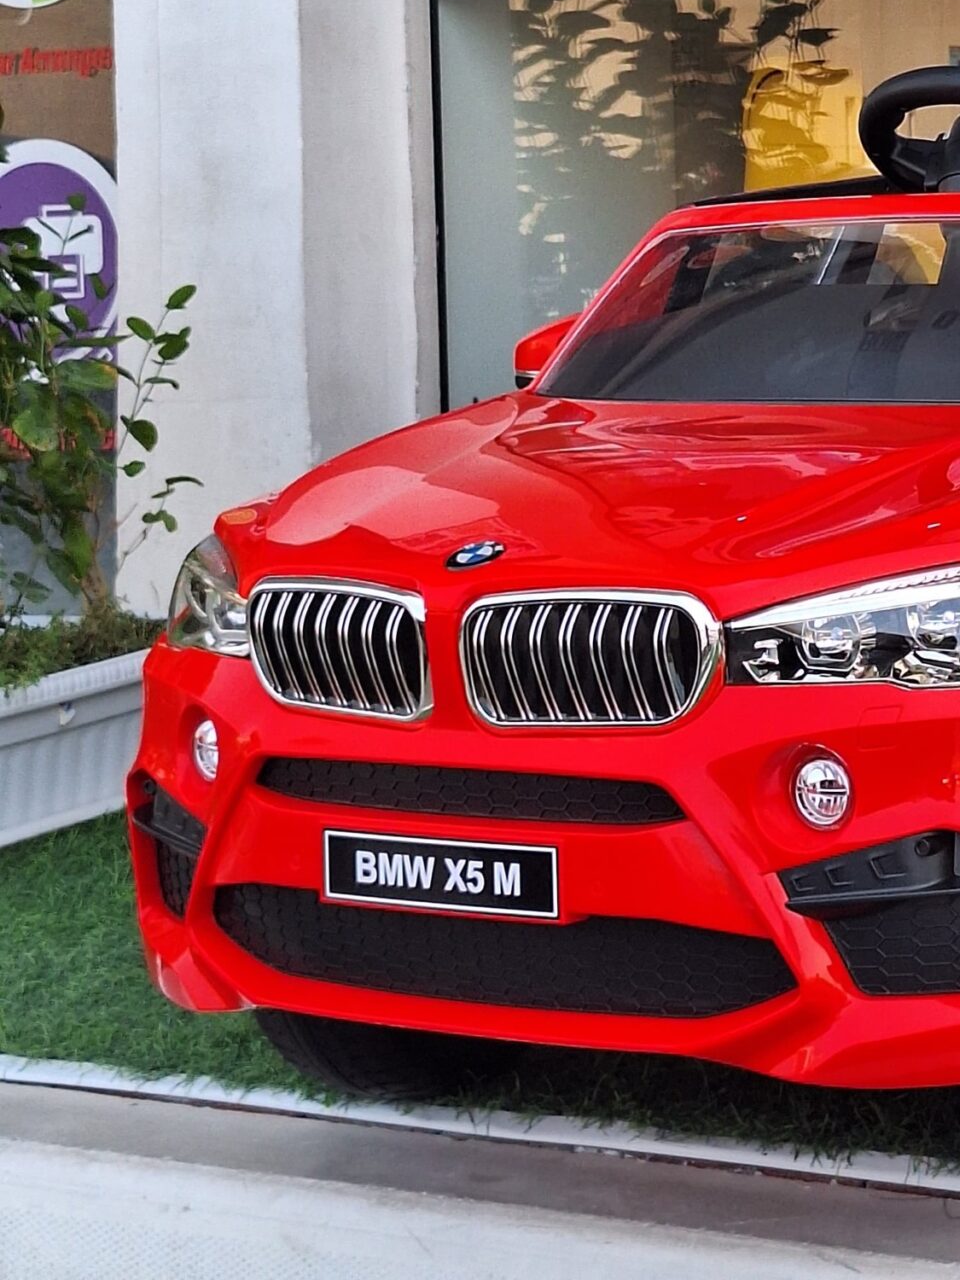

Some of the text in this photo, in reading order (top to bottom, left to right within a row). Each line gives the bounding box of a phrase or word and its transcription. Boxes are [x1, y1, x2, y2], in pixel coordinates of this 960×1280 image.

[355, 849, 522, 897] BMW X5 M
